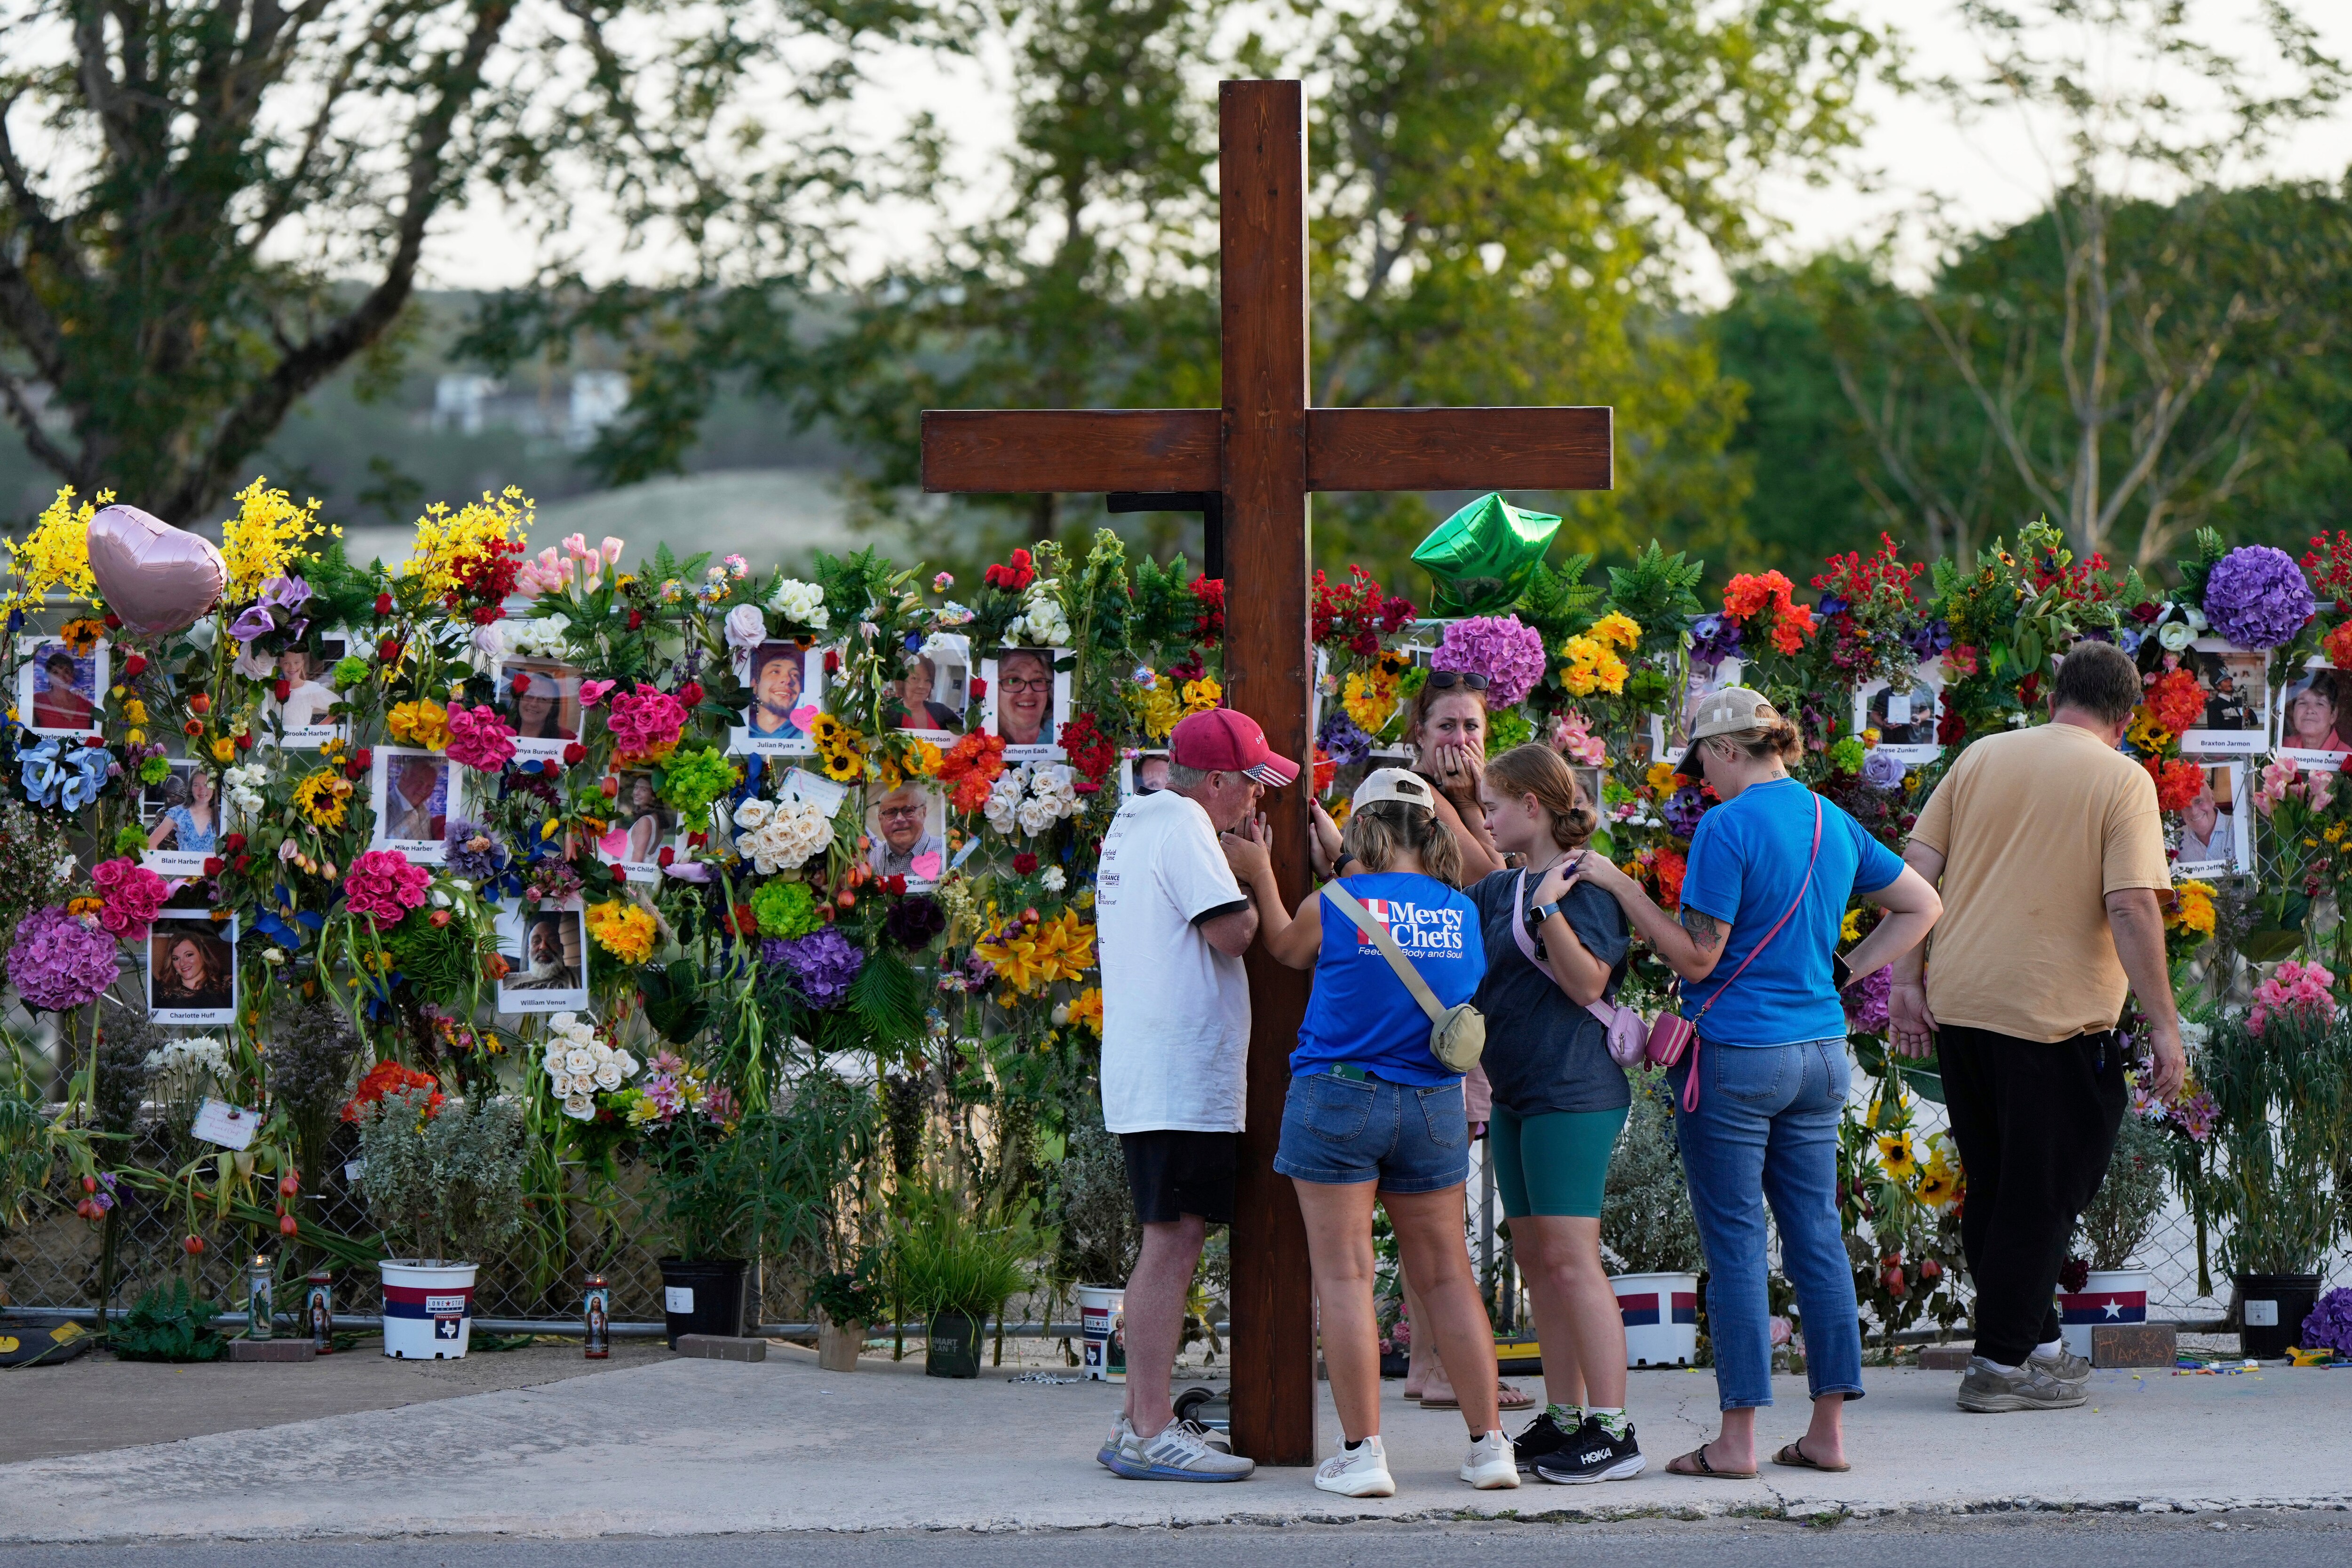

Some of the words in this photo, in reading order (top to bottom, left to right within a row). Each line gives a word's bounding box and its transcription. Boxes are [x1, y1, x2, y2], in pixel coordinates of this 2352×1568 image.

[1388, 900, 1463, 931] Mercy
[1391, 923, 1462, 949] Chefs
[1402, 948, 1425, 958] Body
[1446, 950, 1462, 959] Soul
[931, 1337, 958, 1346] SMART
[931, 1345, 959, 1353] PLANT
[1581, 1447, 1613, 1465] HOKA
